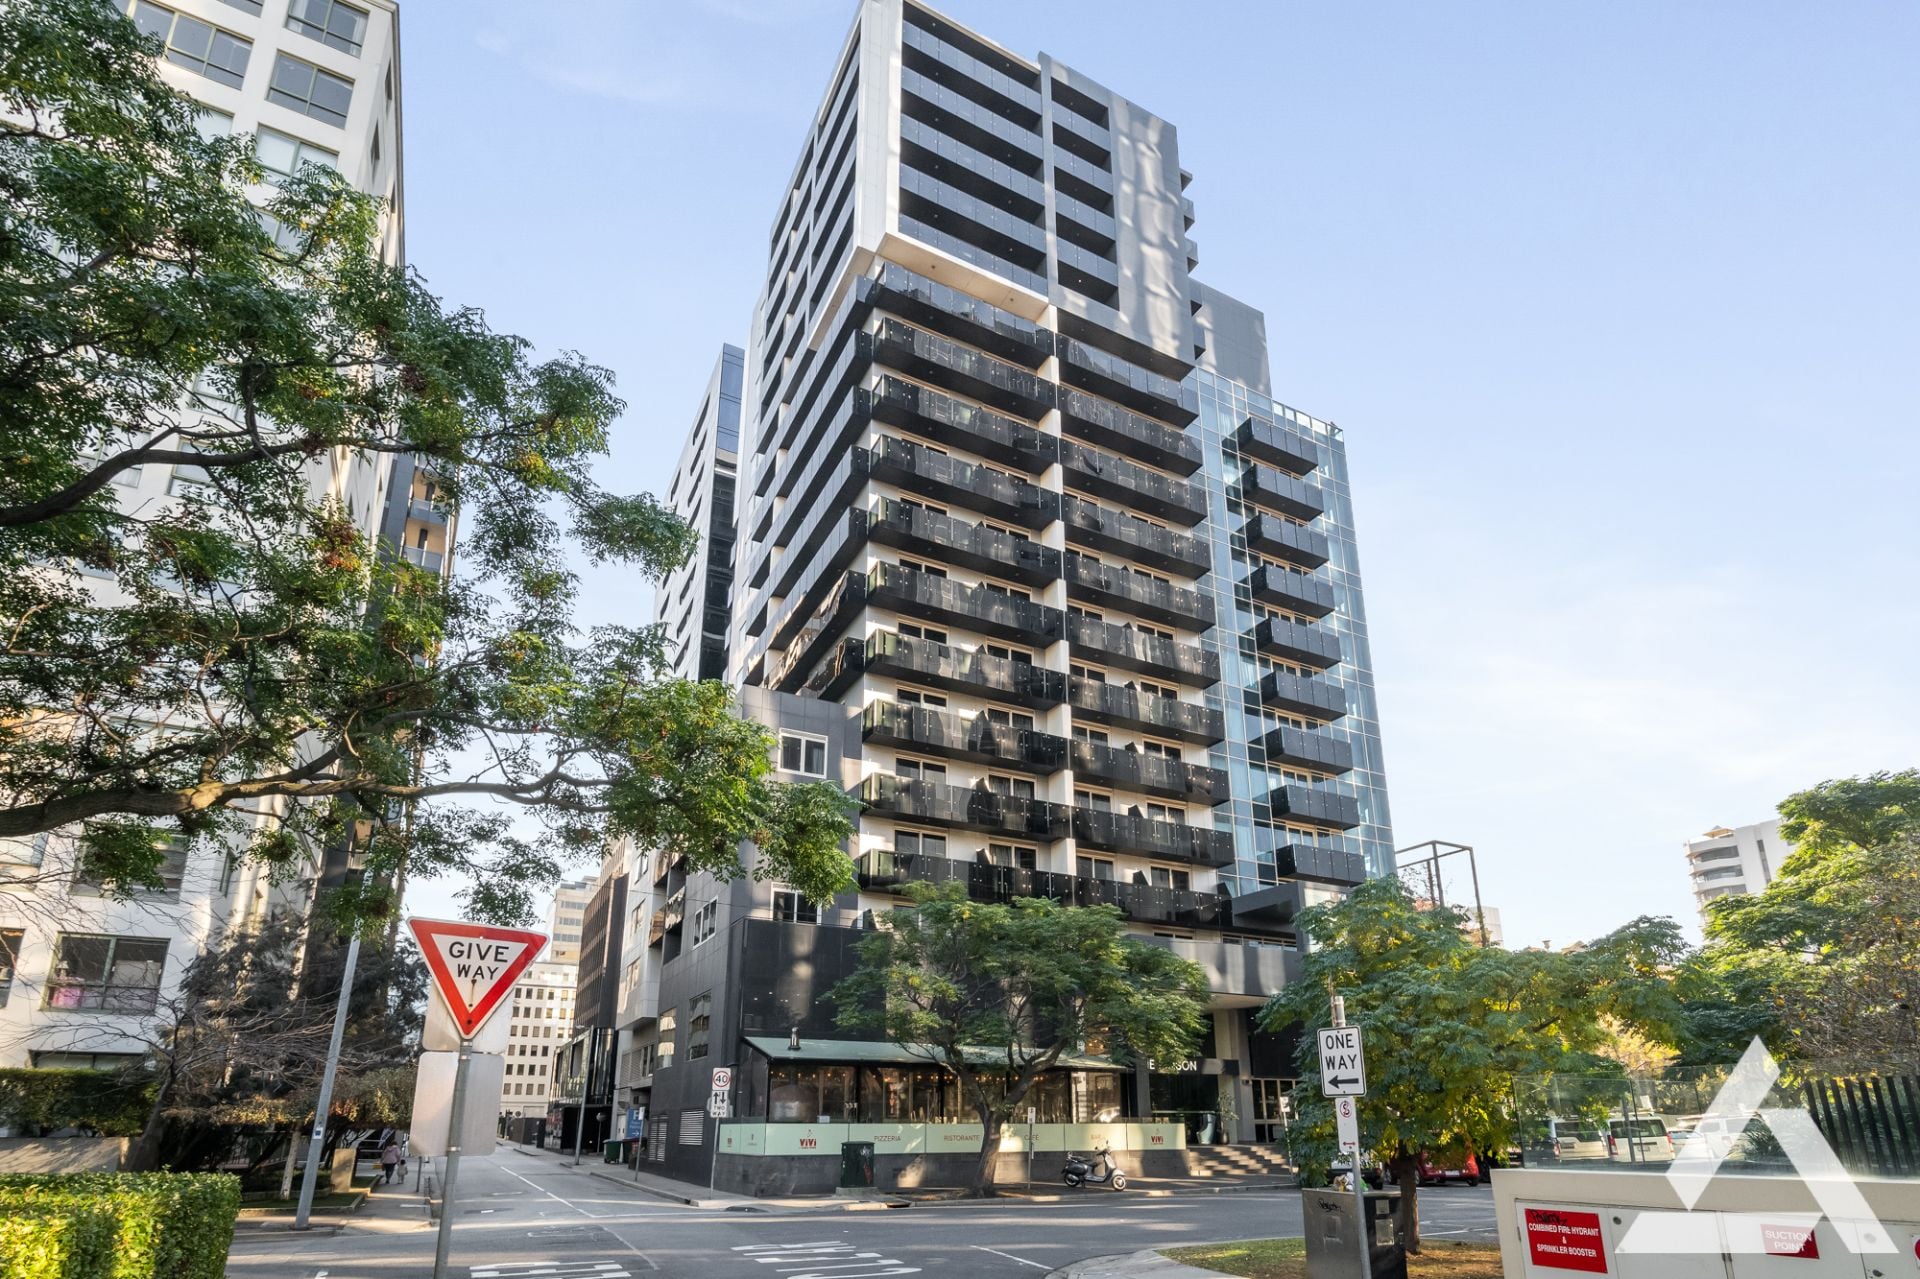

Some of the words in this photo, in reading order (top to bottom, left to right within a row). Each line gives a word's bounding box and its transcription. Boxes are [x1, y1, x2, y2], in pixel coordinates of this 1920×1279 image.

[449, 941, 510, 963] GIVE
[457, 964, 499, 980] WAY
[1325, 1033, 1354, 1050] ONE
[1325, 1054, 1357, 1070] WAY
[715, 1074, 728, 1084] 40
[943, 1134, 981, 1142] RISTORANTE
[1528, 1222, 1558, 1233] COMBINED
[1557, 1225, 1571, 1234] FIRE
[1571, 1227, 1599, 1236] HYDRANT
[1765, 1230, 1812, 1242] SUCTION
[1536, 1244, 1568, 1254] SPRINKLER
[1569, 1247, 1597, 1257] BOOSTER
[1774, 1241, 1807, 1252] POINT
